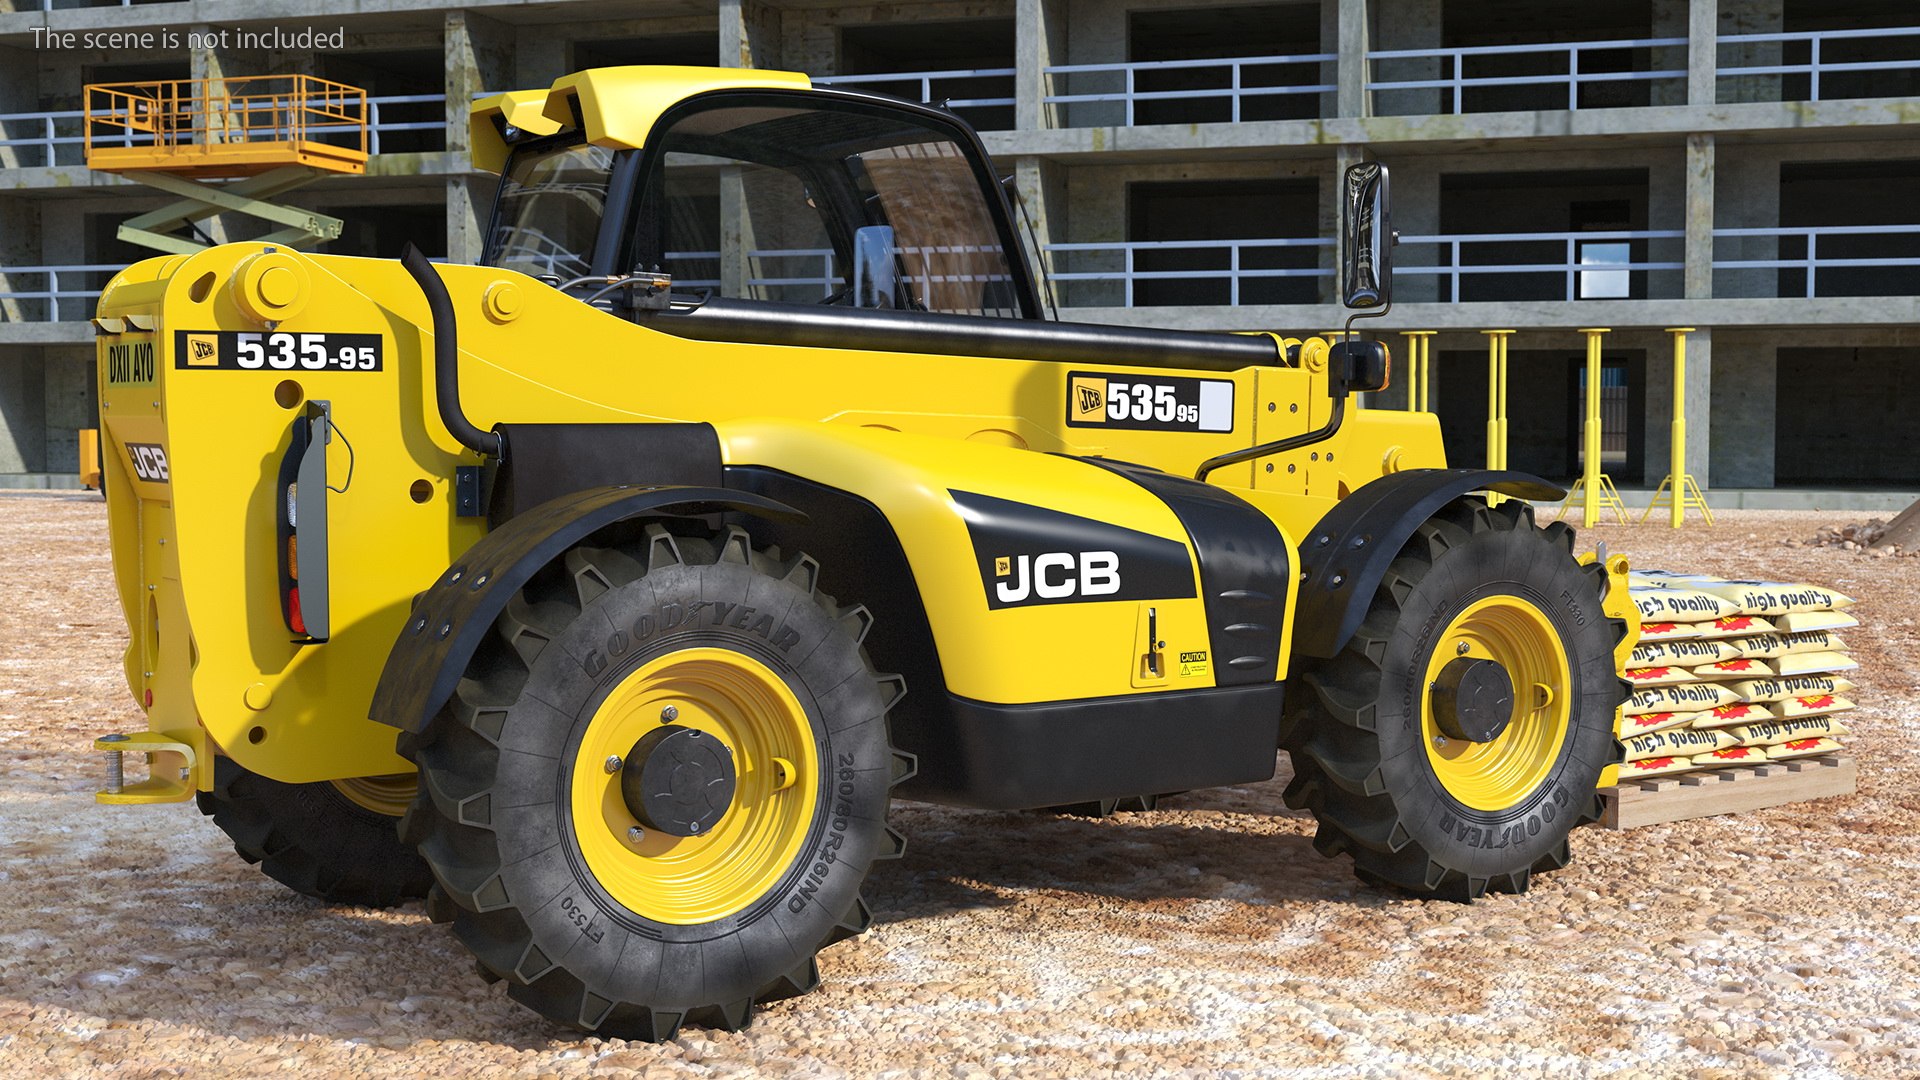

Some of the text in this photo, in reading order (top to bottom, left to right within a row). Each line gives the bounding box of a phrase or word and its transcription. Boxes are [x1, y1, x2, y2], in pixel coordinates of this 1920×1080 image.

[236, 332, 376, 370] 535-95
[1081, 388, 1101, 411] JCB
[132, 446, 168, 480] JCB
[996, 551, 1121, 603] JCB
[1635, 595, 1720, 617] igh quality
[1744, 592, 1777, 611] high
[1669, 640, 1720, 659] quality
[1745, 630, 1829, 653] high quality
[1181, 652, 1206, 663] CAUTION
[1668, 685, 1719, 704] quality
[1752, 675, 1834, 698] high quality
[1747, 715, 1831, 740] high quality
[1631, 729, 1718, 753] high quality
